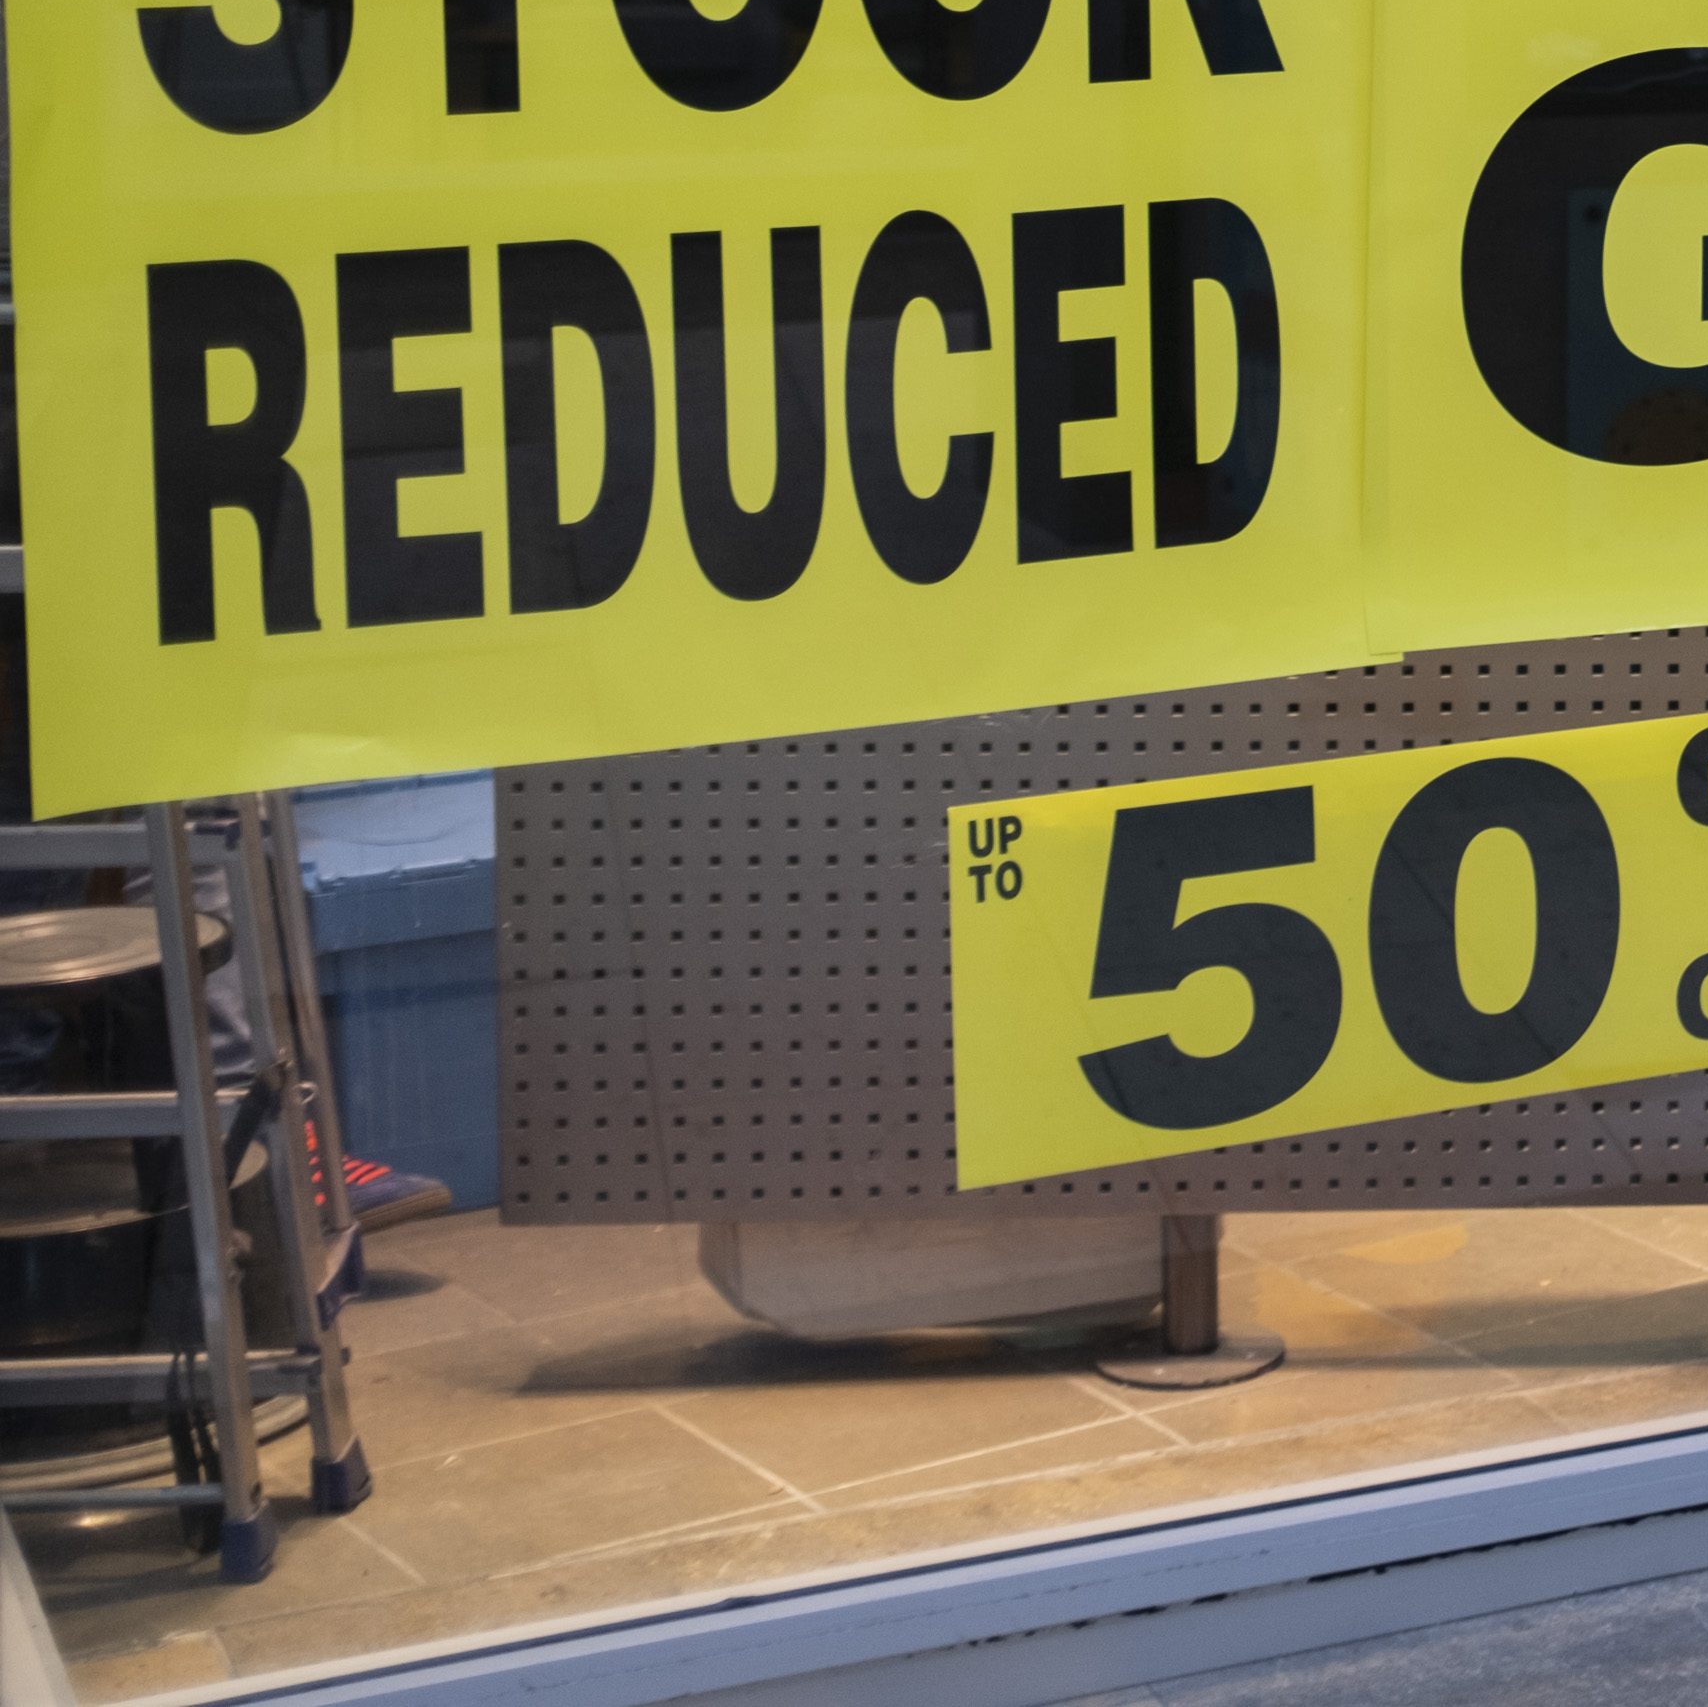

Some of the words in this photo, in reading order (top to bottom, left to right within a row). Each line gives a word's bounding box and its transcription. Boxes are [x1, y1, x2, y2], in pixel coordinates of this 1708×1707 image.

[146, 197, 1282, 647] REDUCED
[967, 814, 1024, 860] UP
[967, 860, 1024, 904] TO
